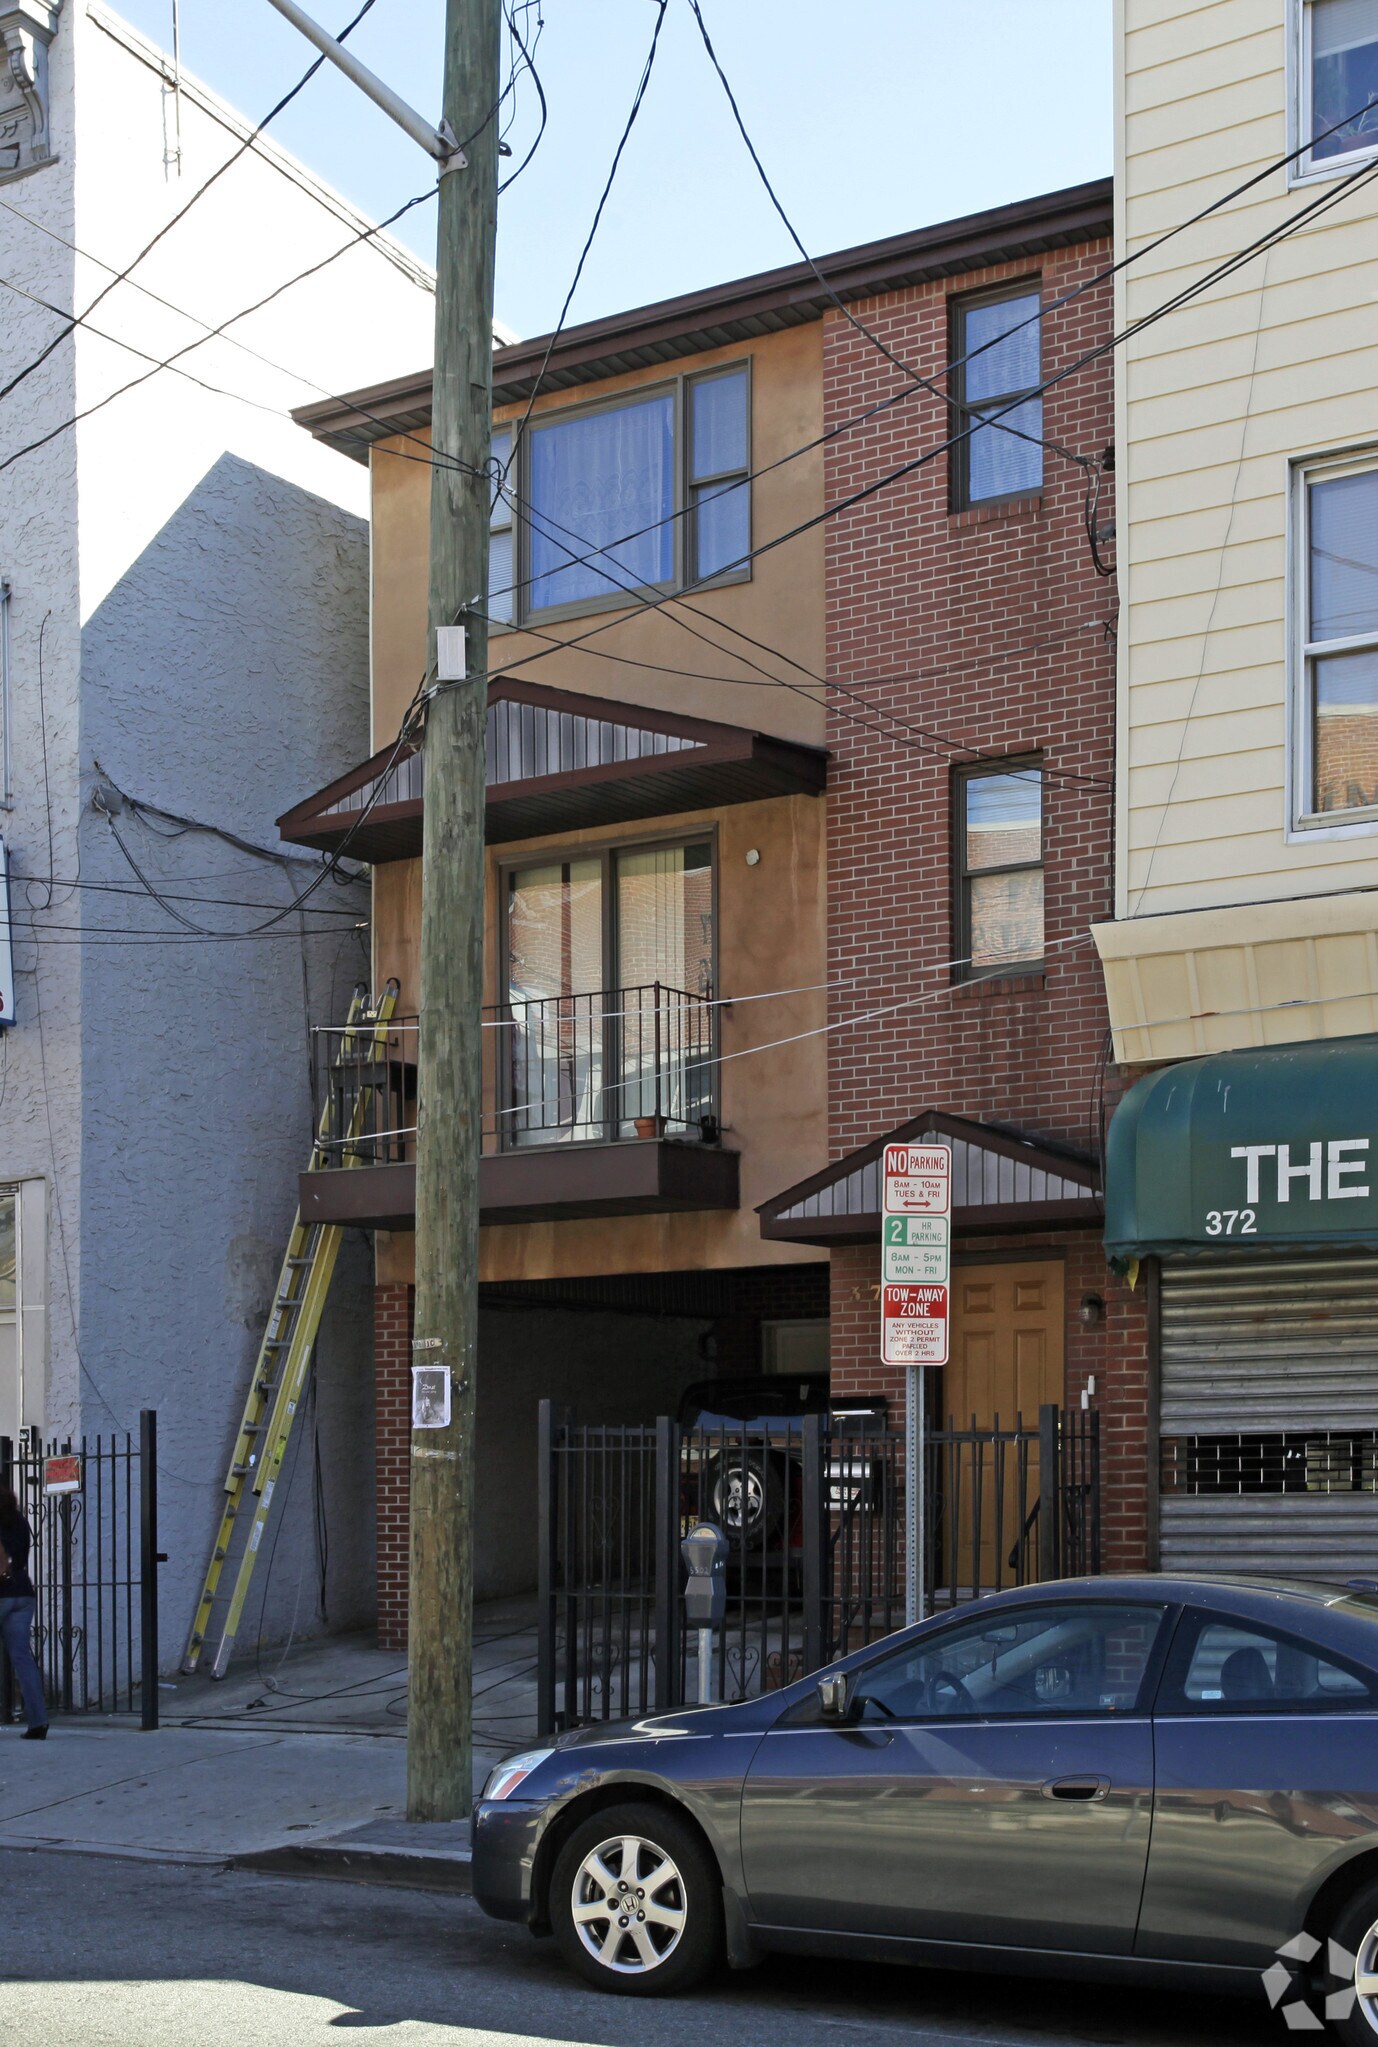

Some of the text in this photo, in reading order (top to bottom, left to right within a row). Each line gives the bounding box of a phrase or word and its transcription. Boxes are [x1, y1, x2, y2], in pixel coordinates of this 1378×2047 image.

[888, 1151, 944, 1173] NO PARKING
[1231, 1138, 1370, 1204] THE
[894, 1180, 909, 1188] 8AM
[921, 1181, 940, 1189] 10AM
[894, 1190, 915, 1198] TUES
[928, 1190, 940, 1198] FRI
[921, 1221, 932, 1230] HR
[1205, 1209, 1257, 1235] 372
[891, 1220, 903, 1242] 2
[911, 1232, 942, 1242] PARKING
[891, 1252, 910, 1262] 8AM
[923, 1253, 941, 1262] 5PM
[895, 1266, 913, 1274] MON
[924, 1266, 937, 1274] FRI
[886, 1287, 945, 1302] TOW-AWAY
[901, 1302, 930, 1316] ZONE
